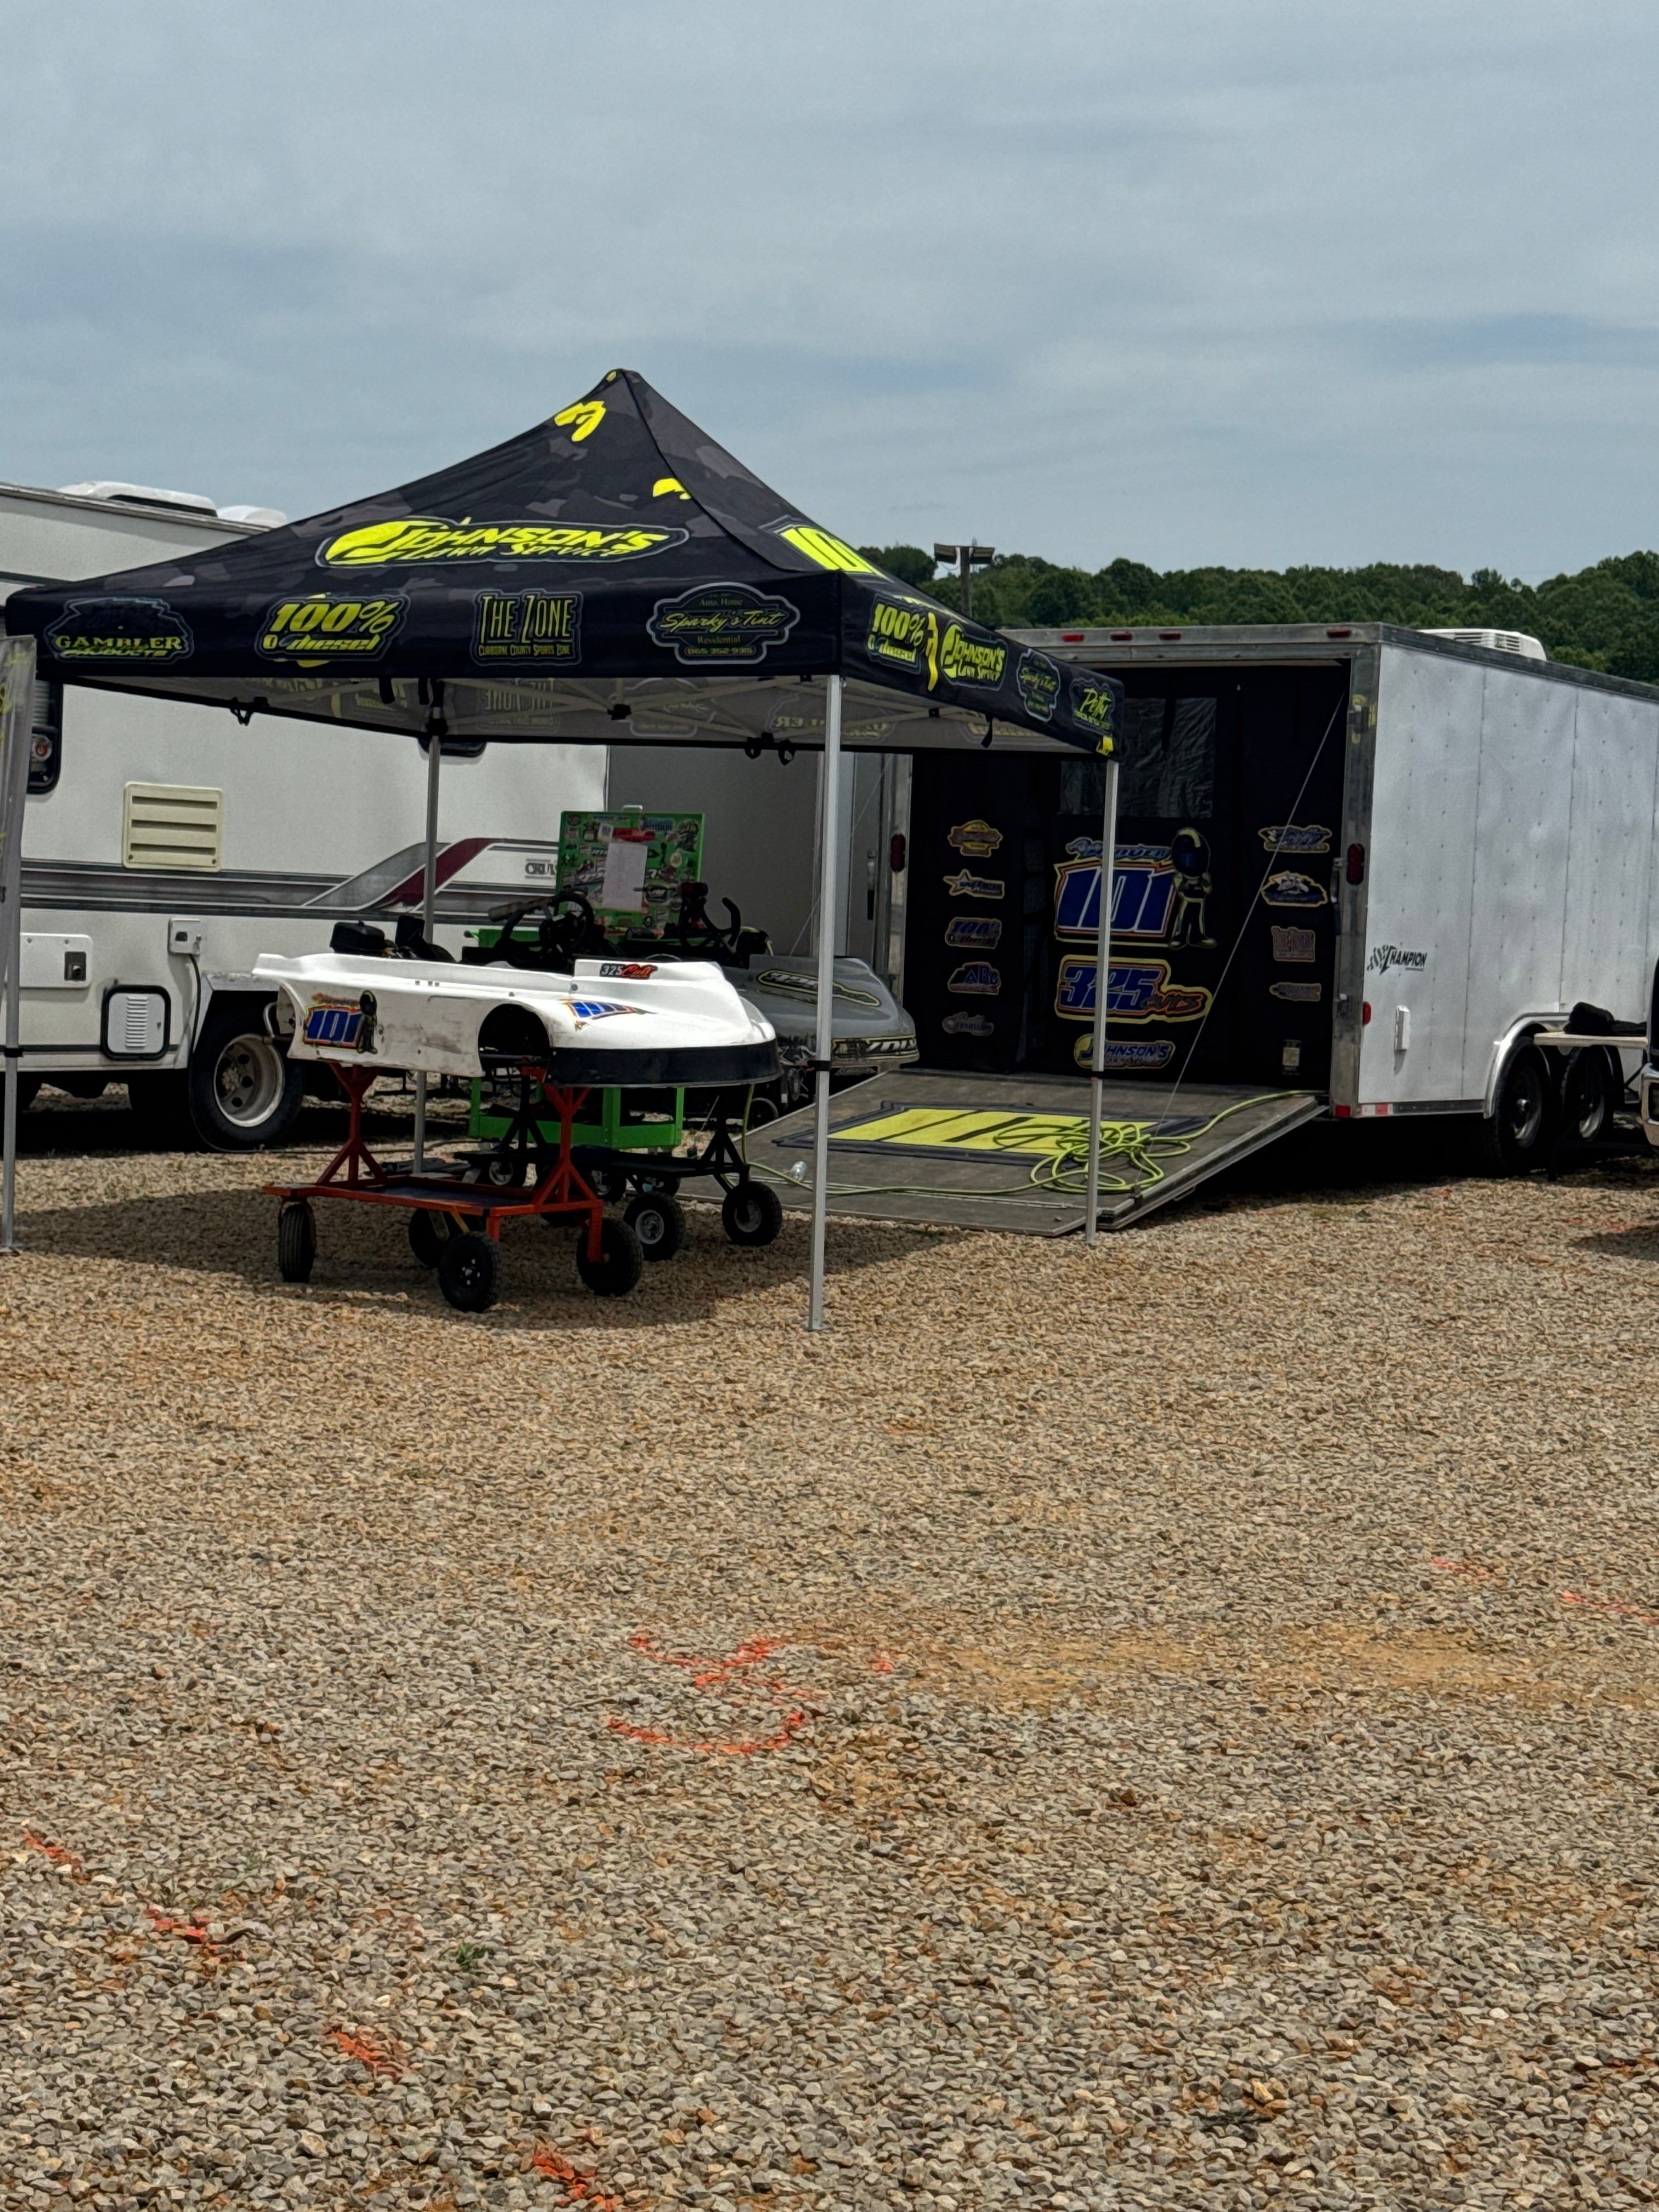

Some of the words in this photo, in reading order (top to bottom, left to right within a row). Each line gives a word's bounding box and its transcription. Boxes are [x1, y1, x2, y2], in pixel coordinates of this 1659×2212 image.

[341, 527, 669, 559] JOHNSON'S
[269, 600, 400, 634] 100%
[480, 595, 516, 645] THE
[521, 594, 574, 644] ZONE
[659, 610, 742, 634] Sparky's
[742, 609, 786, 627] Tint
[873, 603, 926, 647] 100%
[54, 634, 183, 650] GAMBLER
[1380, 945, 1427, 975] CHAMPION
